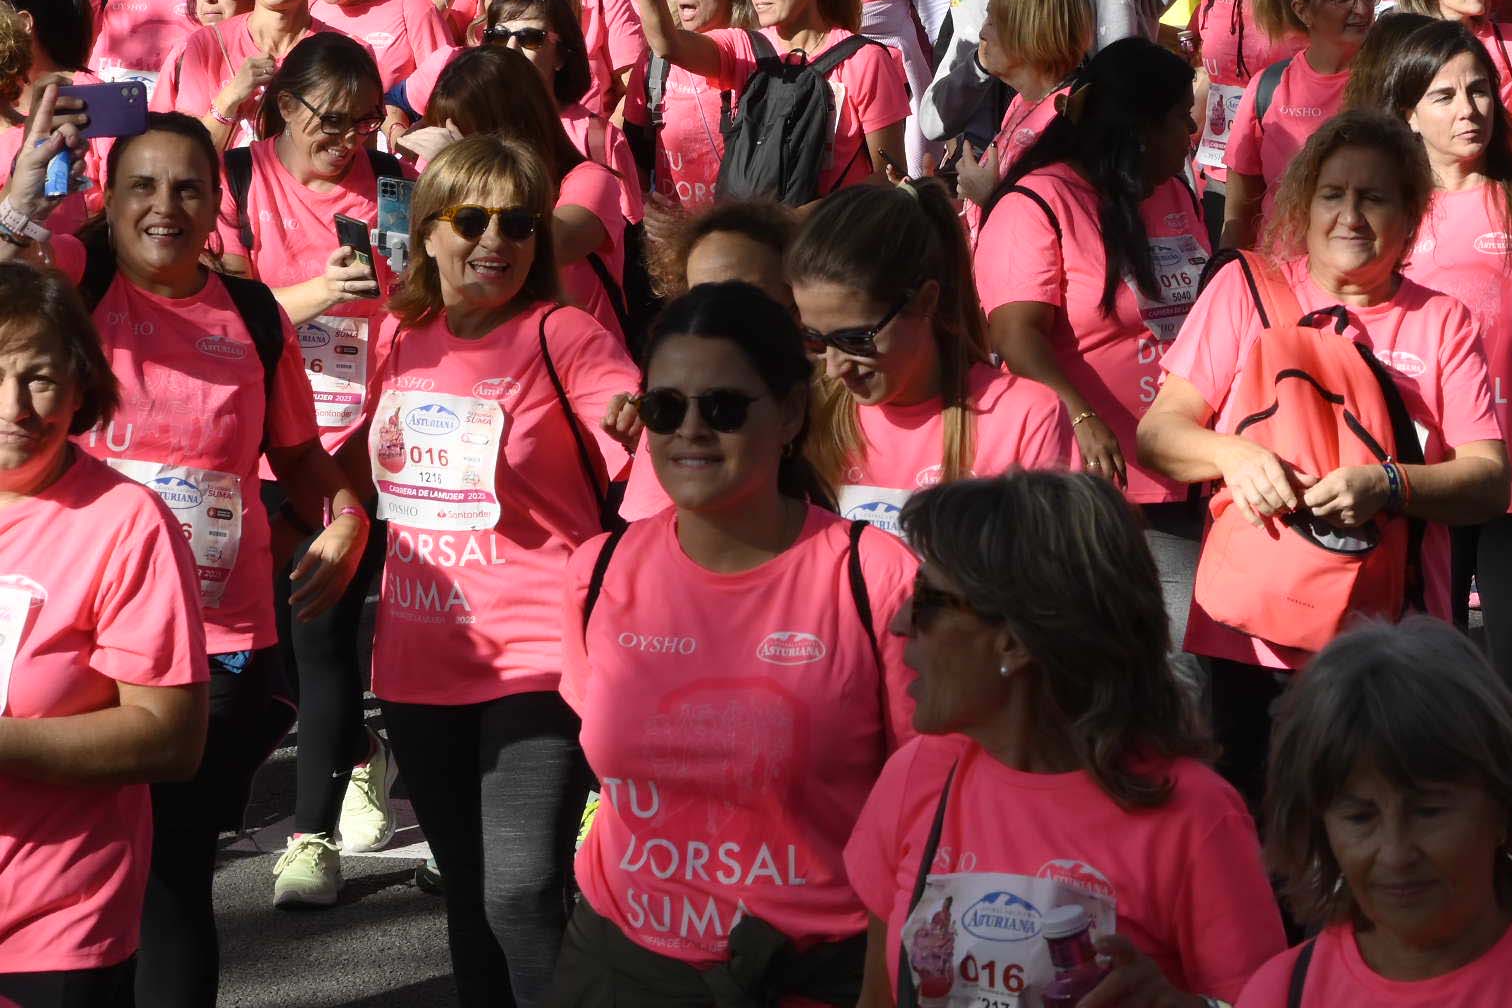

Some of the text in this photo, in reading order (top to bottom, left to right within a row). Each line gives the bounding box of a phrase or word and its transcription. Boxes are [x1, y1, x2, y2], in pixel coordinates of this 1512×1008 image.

[1280, 106, 1322, 117] OYSHO
[1160, 272, 1192, 288] 016
[1172, 291, 1192, 303] 5040
[410, 446, 448, 467] 016
[387, 531, 506, 569] DORSAL
[389, 575, 472, 613] SUMA
[618, 632, 697, 655] OYSHO
[760, 645, 821, 659] ASTURIANA
[603, 777, 659, 818] TU
[619, 835, 807, 885] DORSAL
[960, 955, 1024, 992] 016
